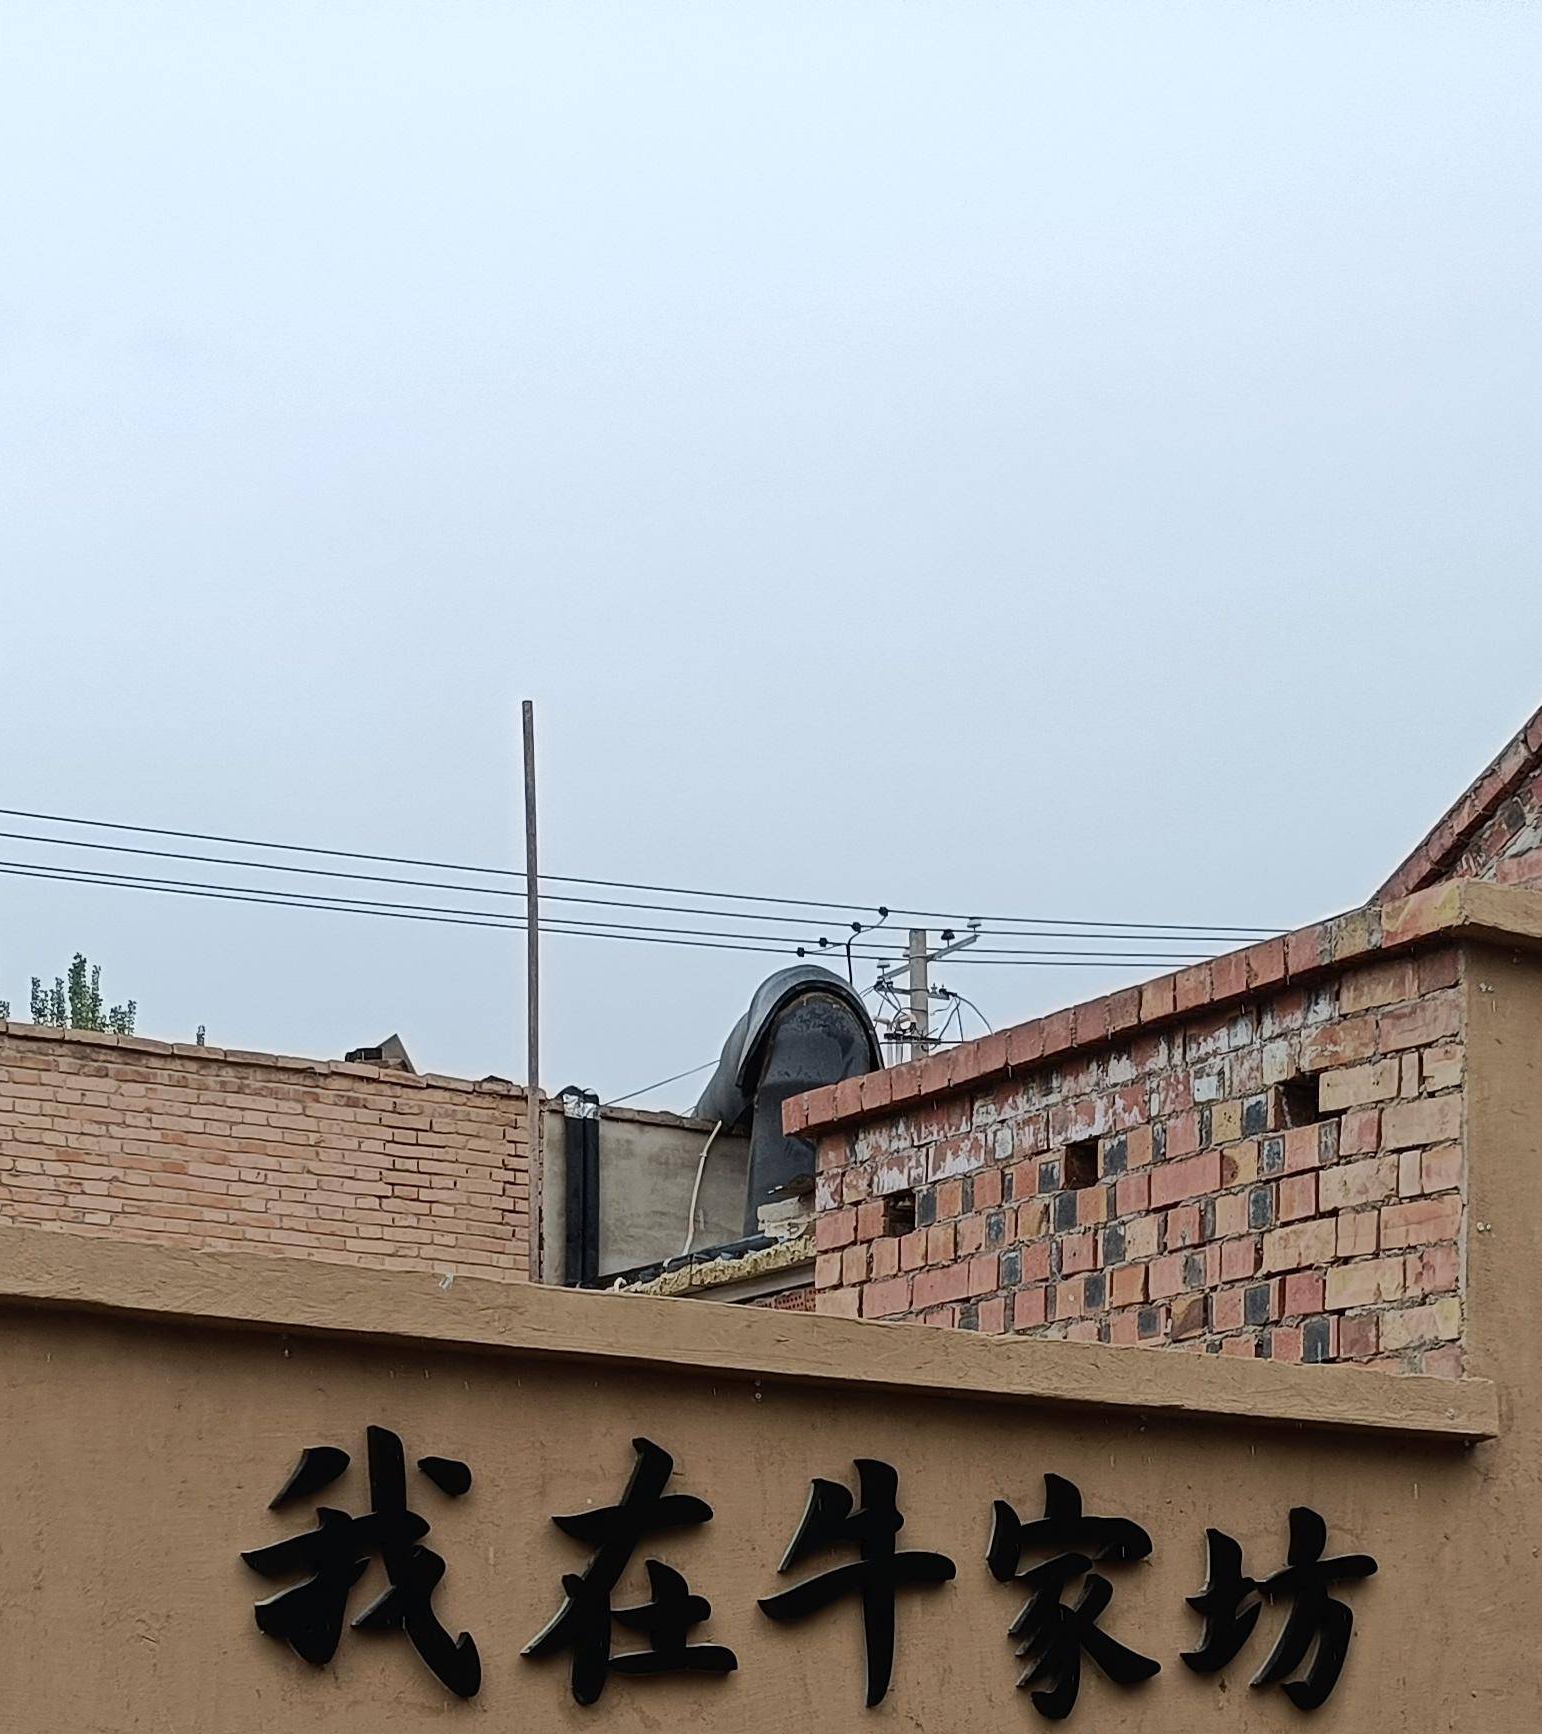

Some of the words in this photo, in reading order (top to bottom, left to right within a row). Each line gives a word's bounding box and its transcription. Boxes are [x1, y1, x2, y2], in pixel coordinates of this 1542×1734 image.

[239, 1424, 1379, 1720] 我在牛家坊
